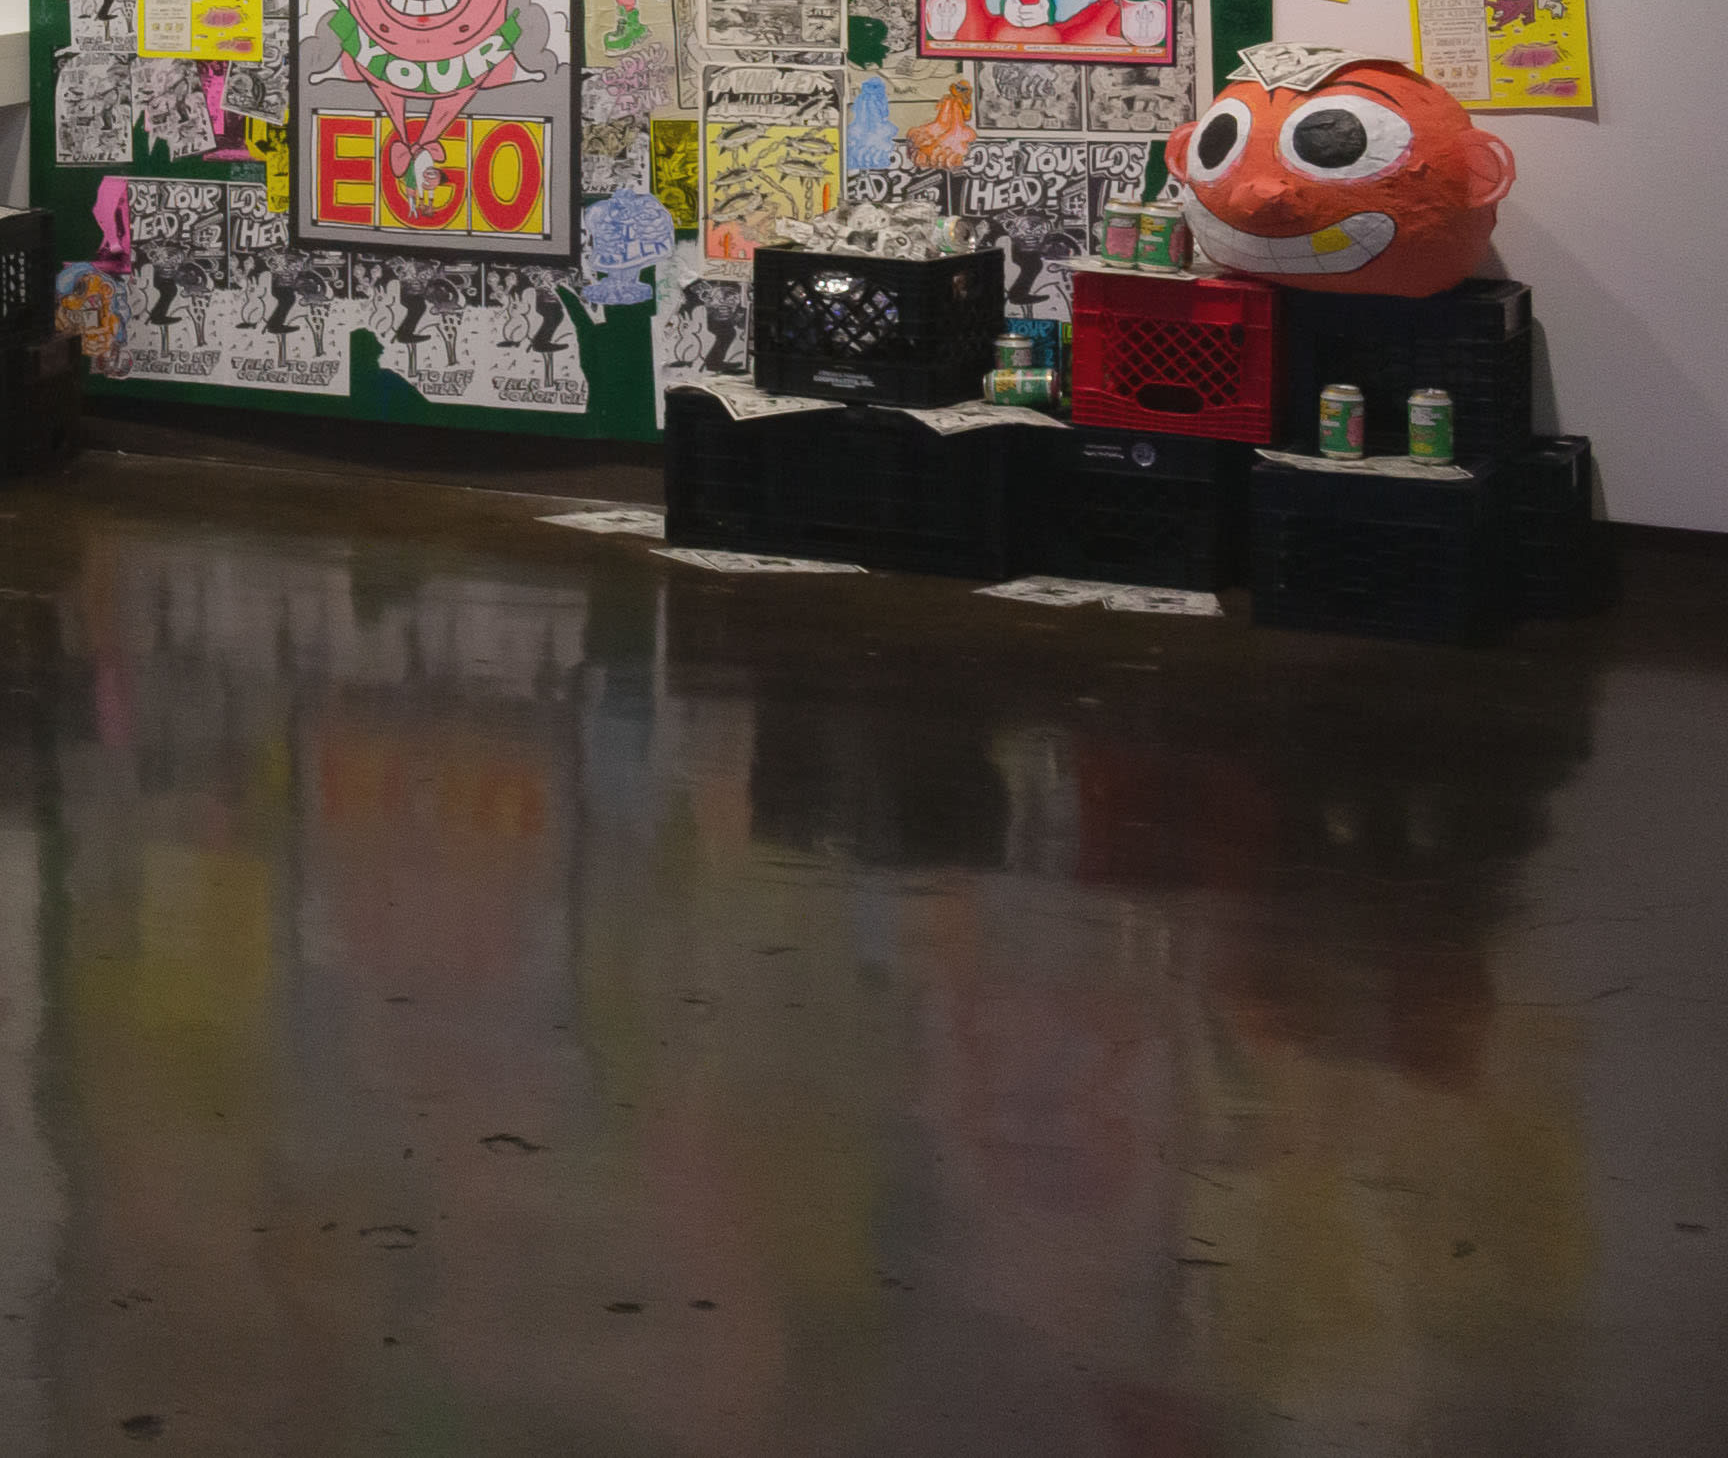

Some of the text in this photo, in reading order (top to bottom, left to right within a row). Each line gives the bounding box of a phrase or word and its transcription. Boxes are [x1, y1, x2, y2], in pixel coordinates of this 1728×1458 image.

[353, 36, 515, 93] YOUR
[59, 152, 116, 162] TUNNEL
[1024, 142, 1086, 175] YOUR
[1092, 144, 1145, 180] LOS
[318, 118, 542, 231] EGO
[161, 182, 220, 213] YOUR
[230, 187, 268, 218] LOS
[965, 172, 1068, 216] HEAD?
